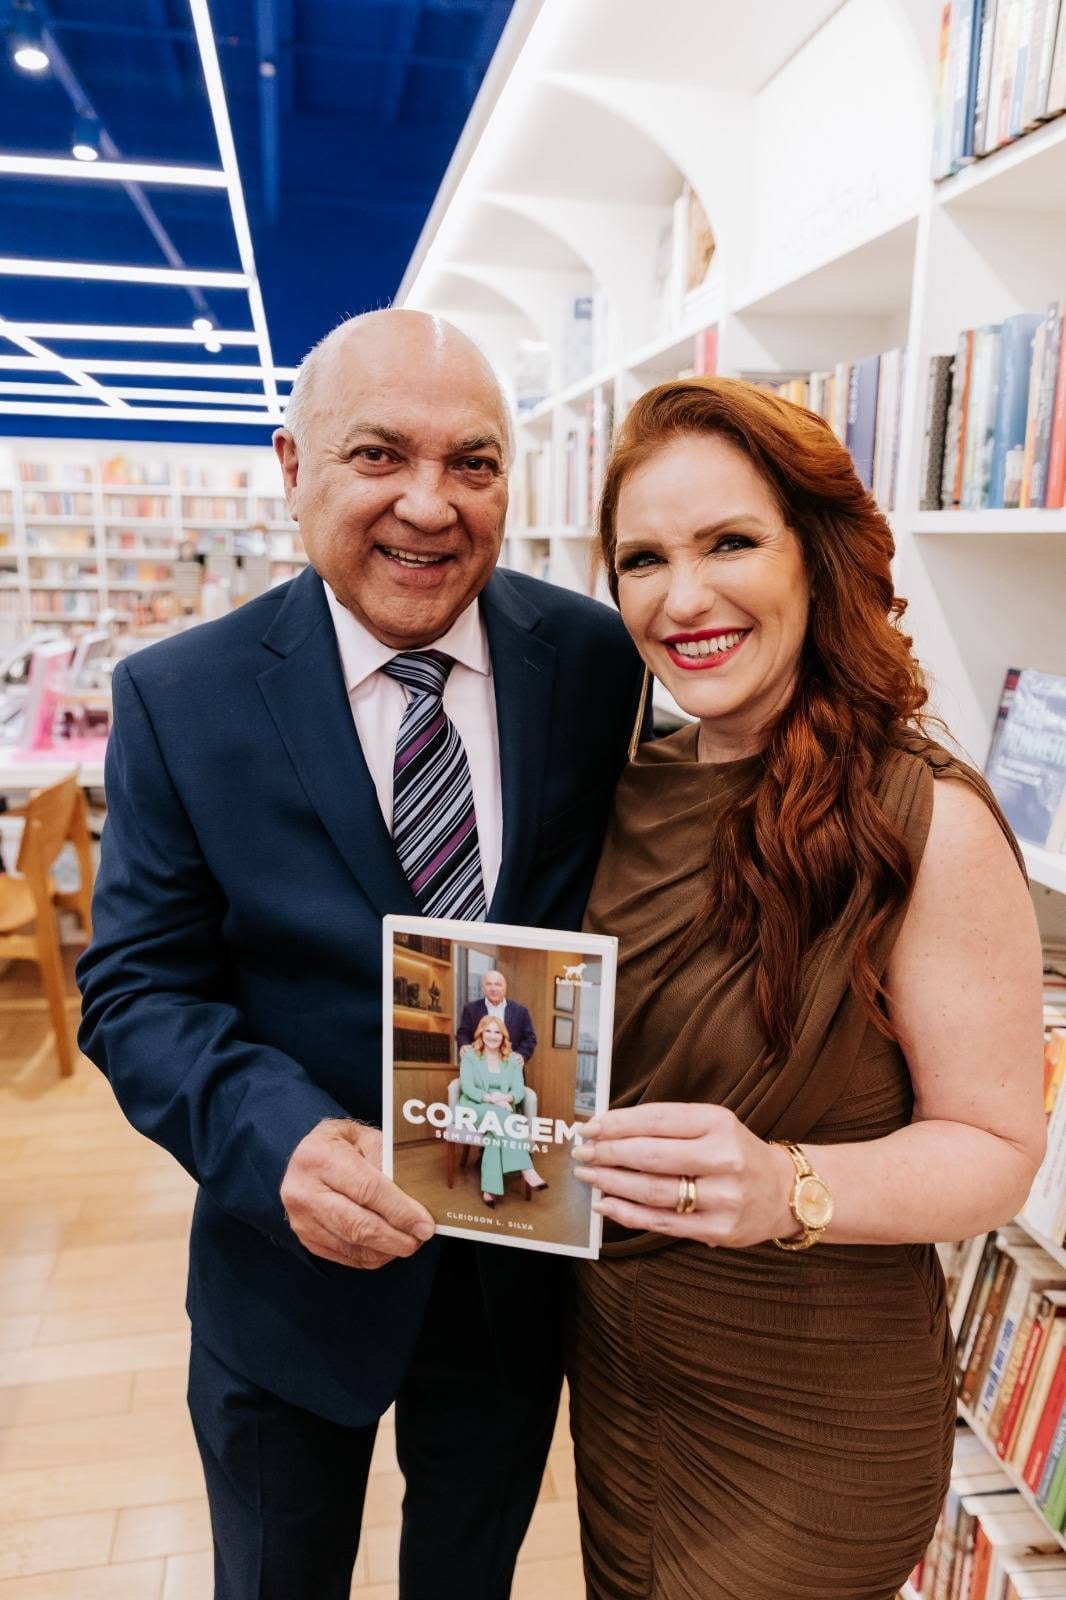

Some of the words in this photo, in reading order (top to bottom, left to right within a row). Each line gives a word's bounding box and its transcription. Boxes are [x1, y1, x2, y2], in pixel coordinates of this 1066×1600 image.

[402, 1098, 584, 1146] CORAGEM
[435, 1129, 460, 1141] SEM
[465, 1134, 549, 1154] FRONTEIRAS
[446, 1212, 493, 1225] CLEIDSON
[508, 1221, 534, 1231] SILVA
